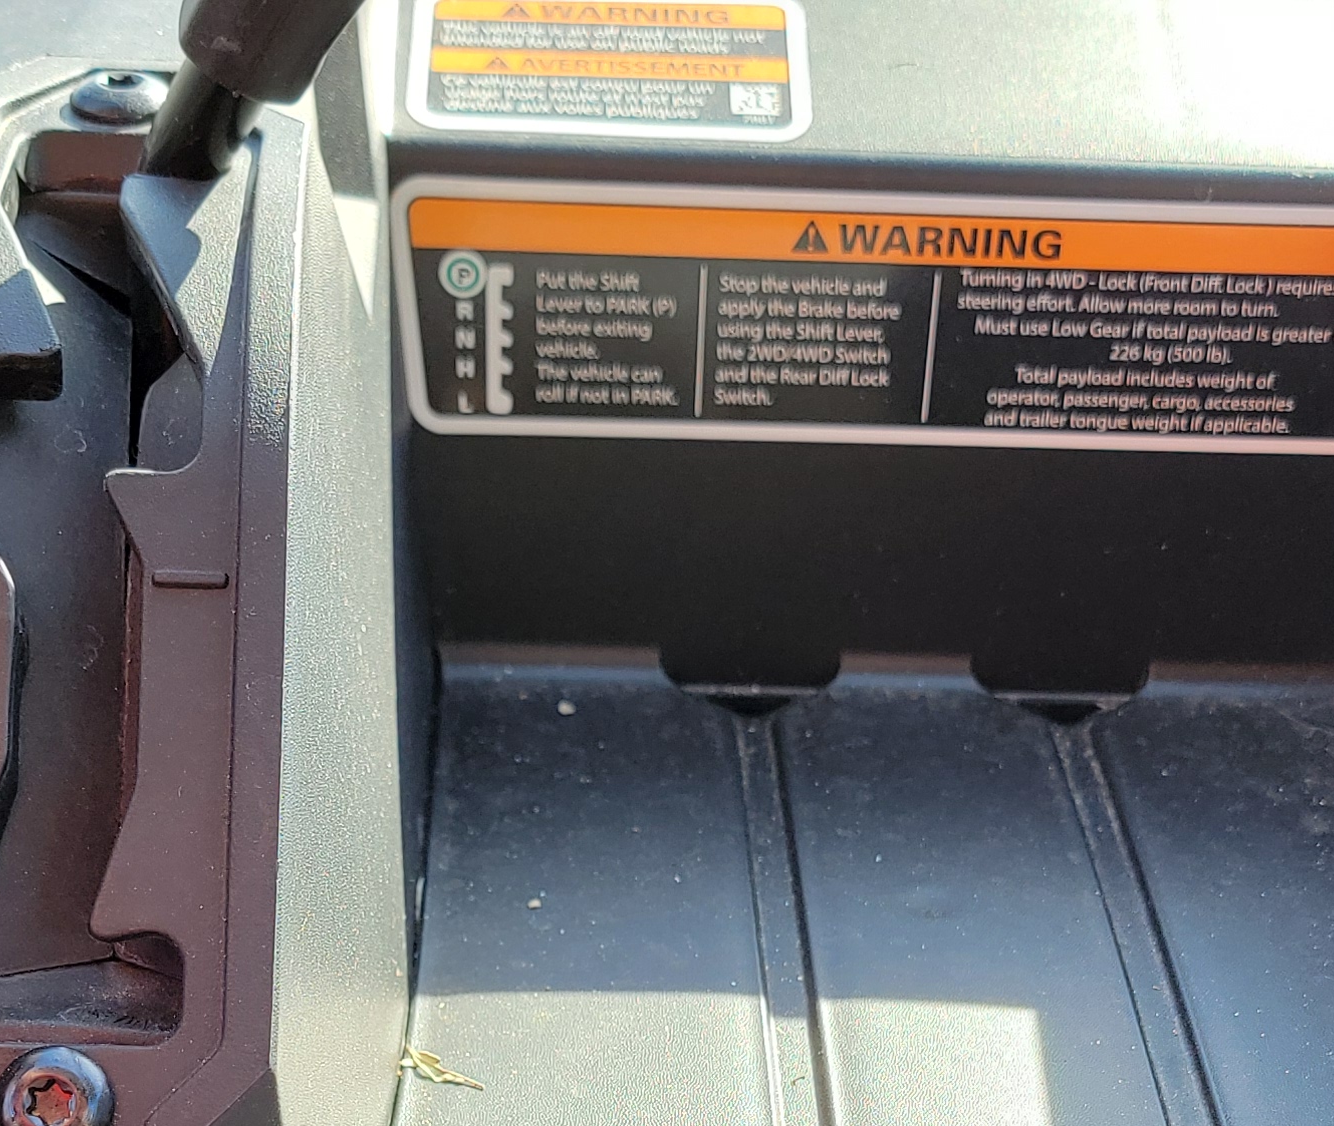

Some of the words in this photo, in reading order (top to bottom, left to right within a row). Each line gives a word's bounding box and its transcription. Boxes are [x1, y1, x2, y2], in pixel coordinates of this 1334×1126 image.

[542, 5, 730, 25] WARNING
[520, 58, 745, 77] AVERTISSEMENT
[838, 223, 1063, 261] WARNING
[536, 270, 565, 290] Put
[568, 271, 598, 290] the
[599, 271, 640, 292] Shift
[719, 274, 759, 296] Stop
[761, 274, 790, 294] the
[791, 275, 851, 296] vehicle
[853, 277, 887, 297] and
[960, 268, 1025, 291] Turning
[1026, 271, 1044, 289] in
[1045, 271, 1088, 290] 4WD
[1098, 273, 1137, 292] Lock
[1139, 273, 1188, 294] (Front
[1190, 275, 1224, 294] Diff.
[455, 300, 474, 321] R
[536, 295, 583, 313] Lever
[584, 297, 603, 314] to
[605, 297, 650, 316] PARK
[652, 295, 677, 318] (P)
[718, 299, 766, 319] apply
[767, 299, 796, 317] the
[798, 299, 845, 318] Brake
[846, 301, 901, 320] before
[958, 290, 1025, 315] steering
[1026, 292, 1076, 312] effort.
[1078, 293, 1127, 314] Allow
[1127, 300, 1172, 315] more
[1173, 302, 1219, 317] room
[1220, 301, 1239, 318] to
[1241, 301, 1279, 318] turn.
[455, 326, 476, 350] N
[536, 317, 591, 336] before
[593, 319, 652, 342] exiting
[718, 321, 764, 343] using
[765, 321, 794, 340] the
[795, 321, 835, 341] Shift
[836, 323, 885, 343] Lever,
[974, 315, 1017, 336] Must
[1019, 319, 1050, 336] use
[1052, 318, 1088, 338] Low
[1089, 319, 1130, 339] Gear
[1131, 319, 1144, 340] if
[1146, 320, 1186, 341] total
[1187, 321, 1255, 344] payload
[1256, 324, 1270, 343] is
[1272, 326, 1332, 346] greater
[535, 341, 600, 359] vehicle.
[717, 341, 745, 361] the
[747, 342, 834, 364] 2WD/4WD
[835, 344, 891, 365] Switch
[1109, 342, 1142, 361] 226
[1143, 343, 1167, 365] kg
[1168, 344, 1203, 364] (500
[1206, 345, 1233, 365] lb).
[455, 356, 476, 379] H
[535, 360, 567, 381] The
[569, 362, 630, 383] vehicle
[631, 365, 662, 383] can
[715, 365, 748, 384] and
[750, 365, 778, 385] the
[780, 366, 817, 386] Rear
[819, 367, 849, 386] Diff
[851, 368, 890, 387] Lock
[1015, 363, 1057, 384] Total
[1057, 365, 1125, 388] payload
[1127, 367, 1194, 388] includes
[1197, 371, 1254, 392] weight
[1255, 371, 1279, 391] of
[457, 391, 474, 414] L
[535, 384, 564, 403] roll
[566, 384, 579, 404] if
[580, 386, 610, 405] not
[611, 386, 629, 405] in
[630, 386, 679, 407] PARK.
[714, 386, 774, 406] Switch.
[986, 387, 1061, 408] operator,
[1063, 389, 1150, 411] passenger,
[1152, 393, 1201, 413] cargo,
[1204, 395, 1296, 413] accessories
[984, 407, 1017, 427] and
[1019, 408, 1067, 429] trailer
[1070, 411, 1130, 432] tongue
[1132, 412, 1189, 435] weight
[1190, 414, 1203, 433] if
[1203, 414, 1291, 436] applicable.
